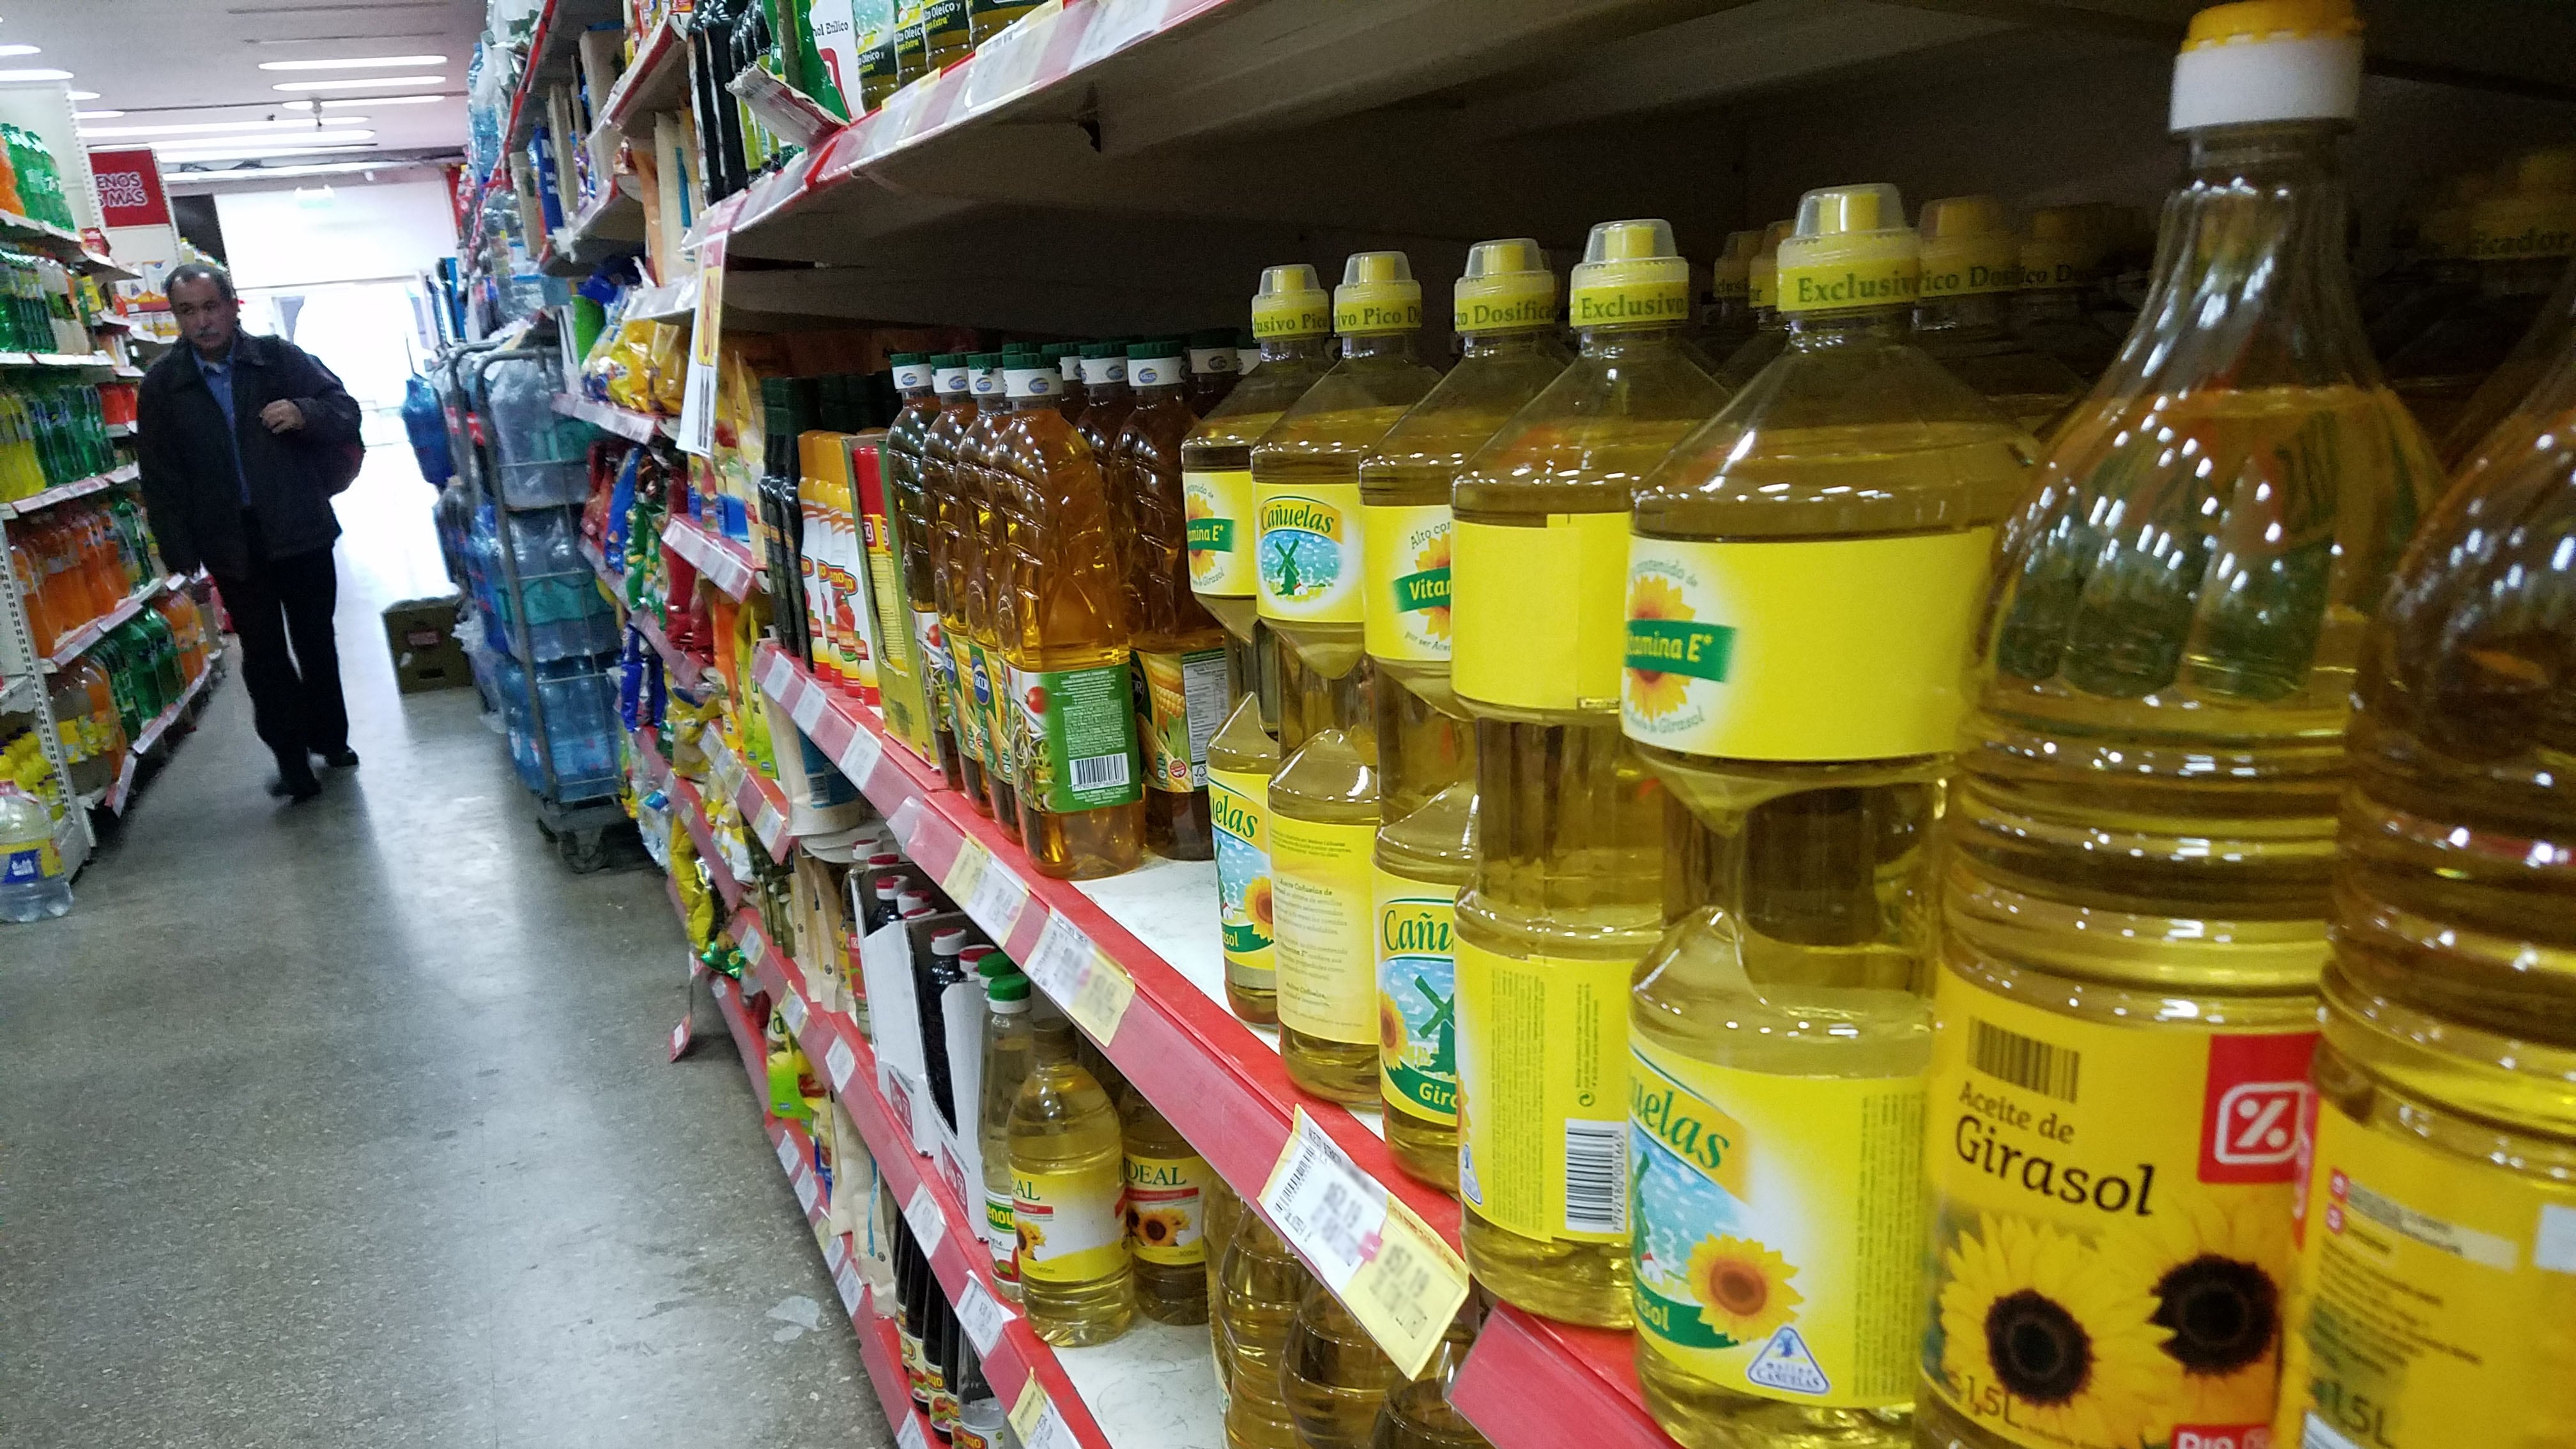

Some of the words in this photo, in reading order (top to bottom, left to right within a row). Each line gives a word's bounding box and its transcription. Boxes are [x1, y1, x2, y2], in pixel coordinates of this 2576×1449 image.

[1363, 307, 1402, 325] Pico
[1261, 504, 1334, 533] Cañuelas
[1410, 530, 1432, 550] Alto
[1958, 1080, 2032, 1131] Aceite
[2037, 1112, 2076, 1144] de
[1956, 1114, 2155, 1217] Girasol
[1012, 1174, 1041, 1201] AL
